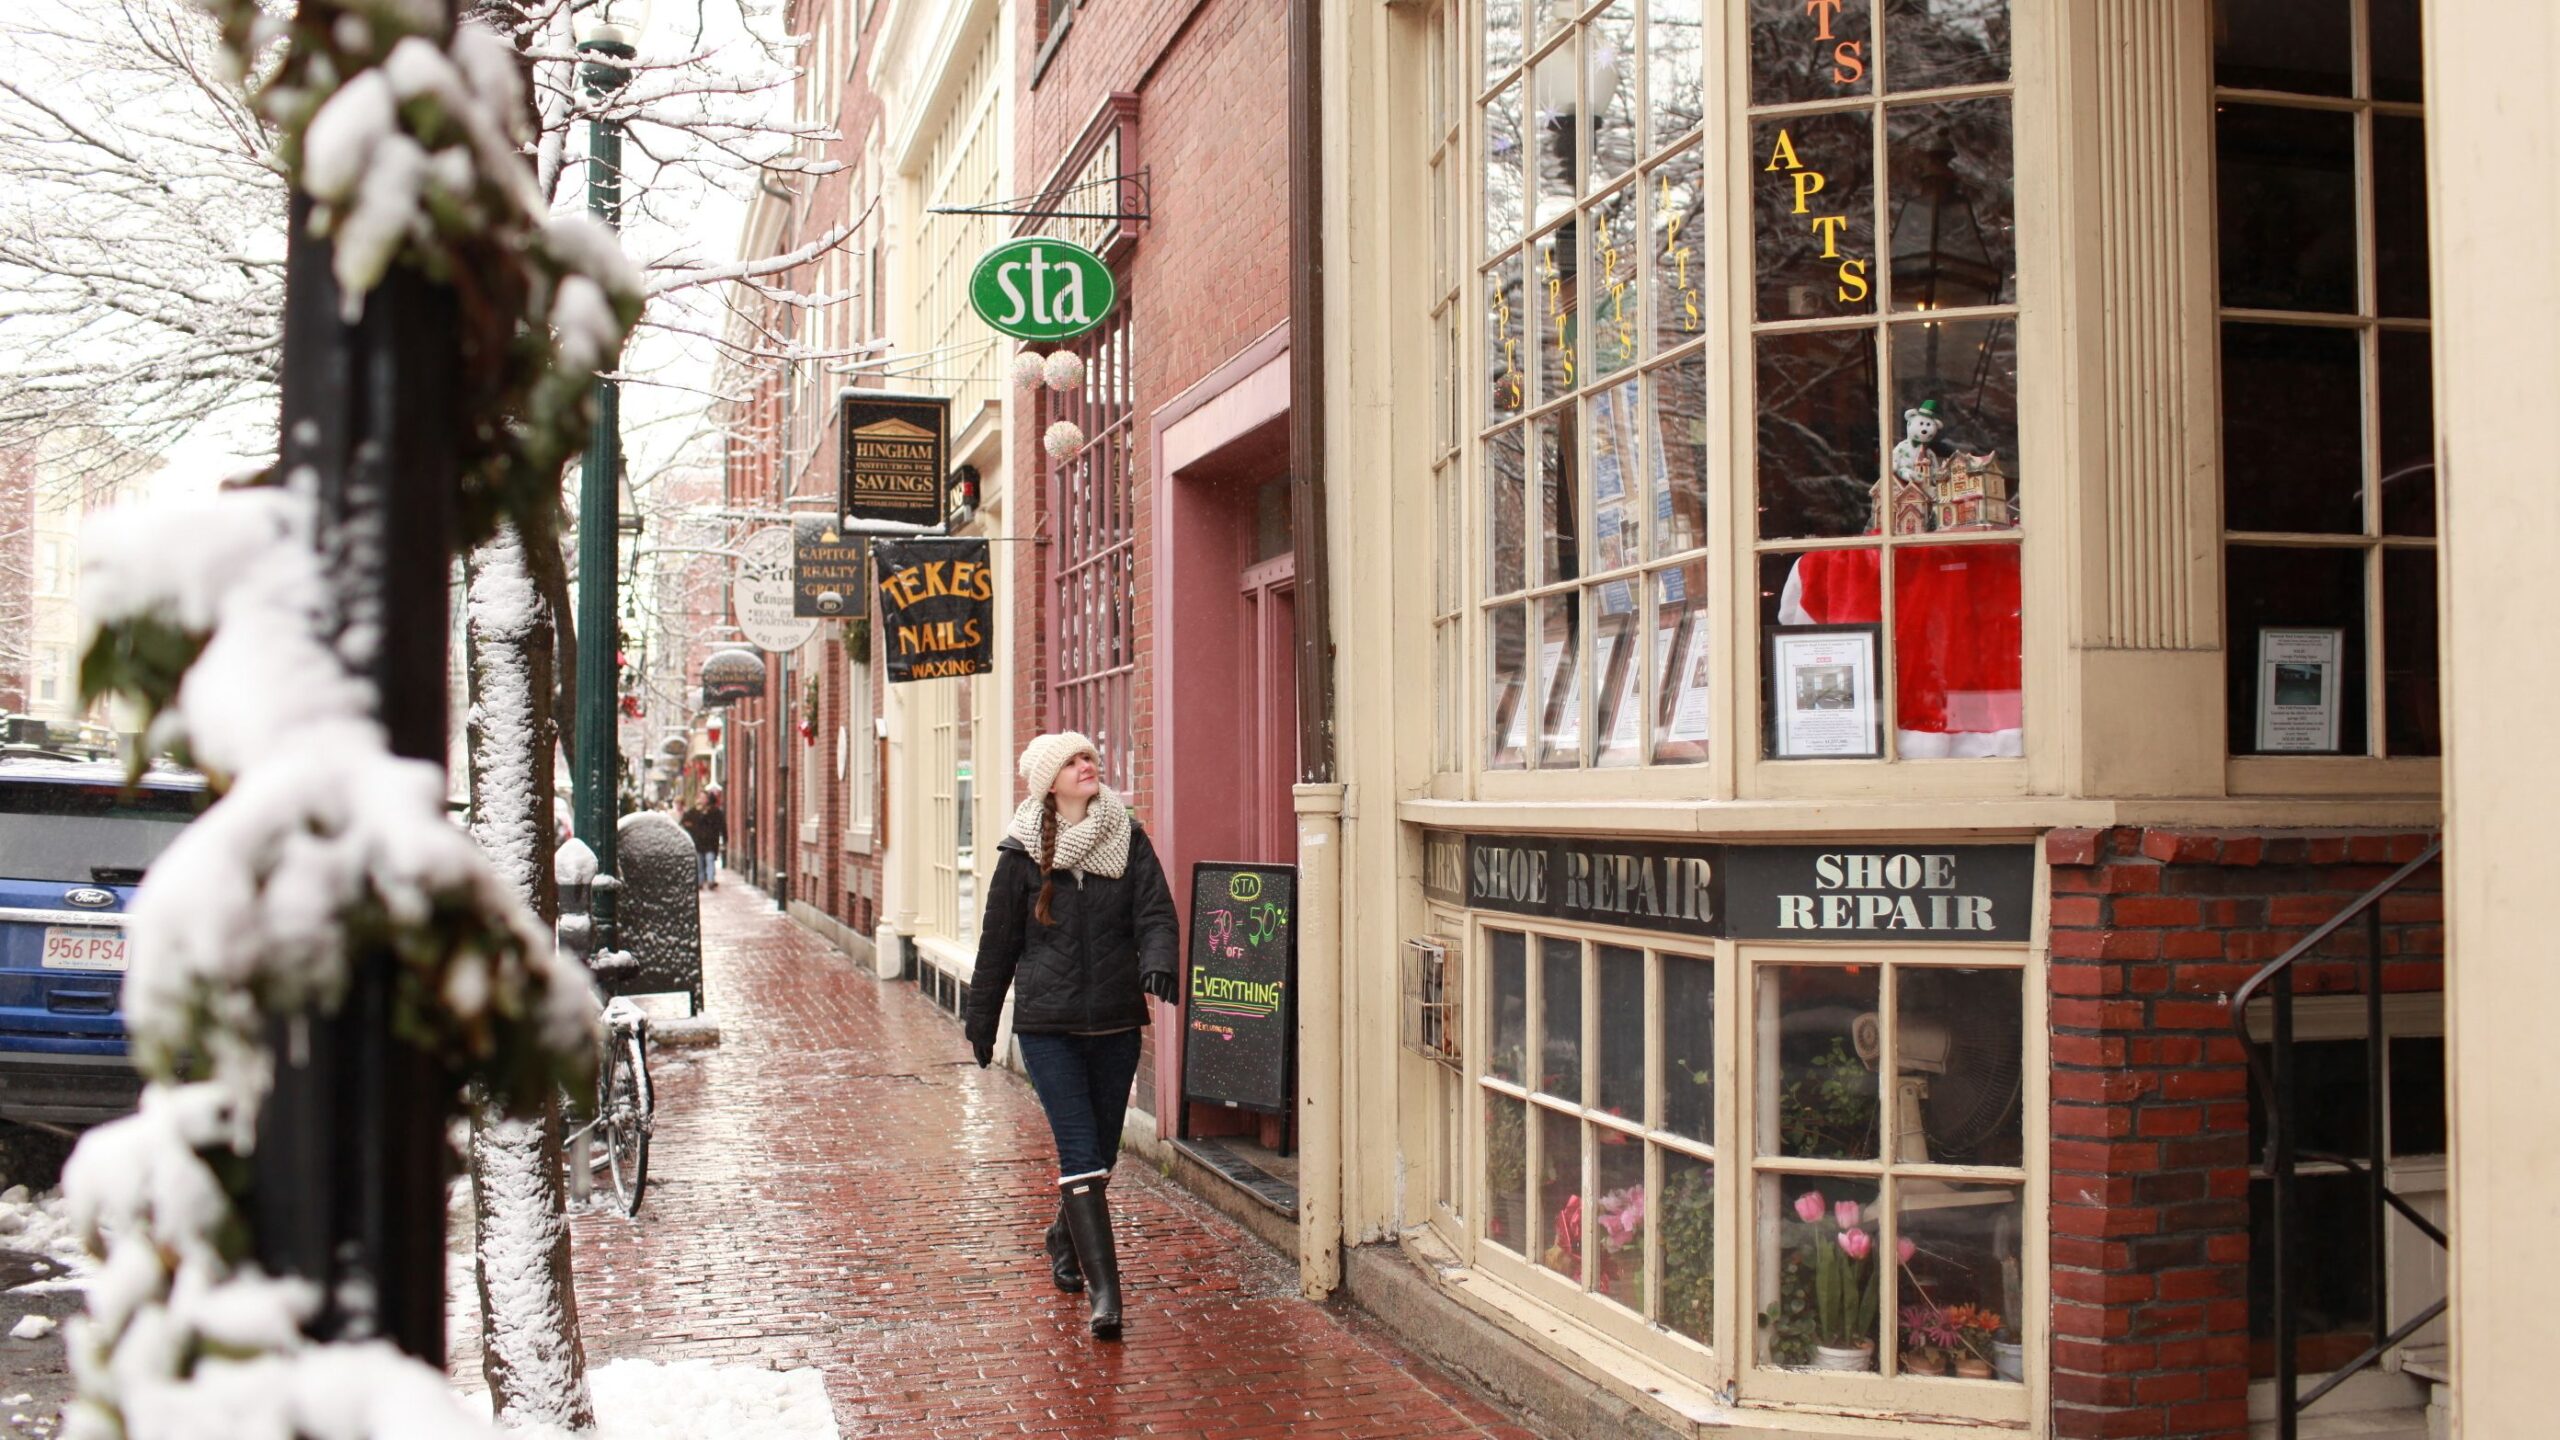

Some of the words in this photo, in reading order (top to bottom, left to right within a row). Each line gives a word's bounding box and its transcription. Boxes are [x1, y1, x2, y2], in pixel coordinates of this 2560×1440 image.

[1764, 129, 1868, 302] APTS
[1660, 174, 1698, 332] APTS
[997, 247, 1091, 325] sta
[1597, 213, 1632, 360] APTS
[1541, 246, 1573, 386] APTS
[1492, 274, 1522, 408] APTS
[856, 442, 932, 459] HINGHAM
[856, 462, 913, 470] INSTITUTION
[915, 463, 932, 471] FOR
[855, 474, 934, 492] SAVINGS
[799, 547, 858, 560] CAPITOL
[802, 566, 856, 578] REALTY
[880, 560, 993, 610] TEKE'S
[804, 583, 855, 596] GROUP
[898, 618, 981, 655] NAILS
[911, 660, 975, 679] WAXING
[1233, 878, 1256, 895] STA
[1473, 846, 1548, 904] SHOE
[1565, 852, 1713, 922] REPAIR
[1815, 854, 1956, 890] SHOE
[75, 891, 104, 903] Ford
[1777, 894, 1996, 931] REPAIR
[47, 937, 84, 959] 956
[89, 939, 126, 960] PS4
[1226, 946, 1245, 959] OFF
